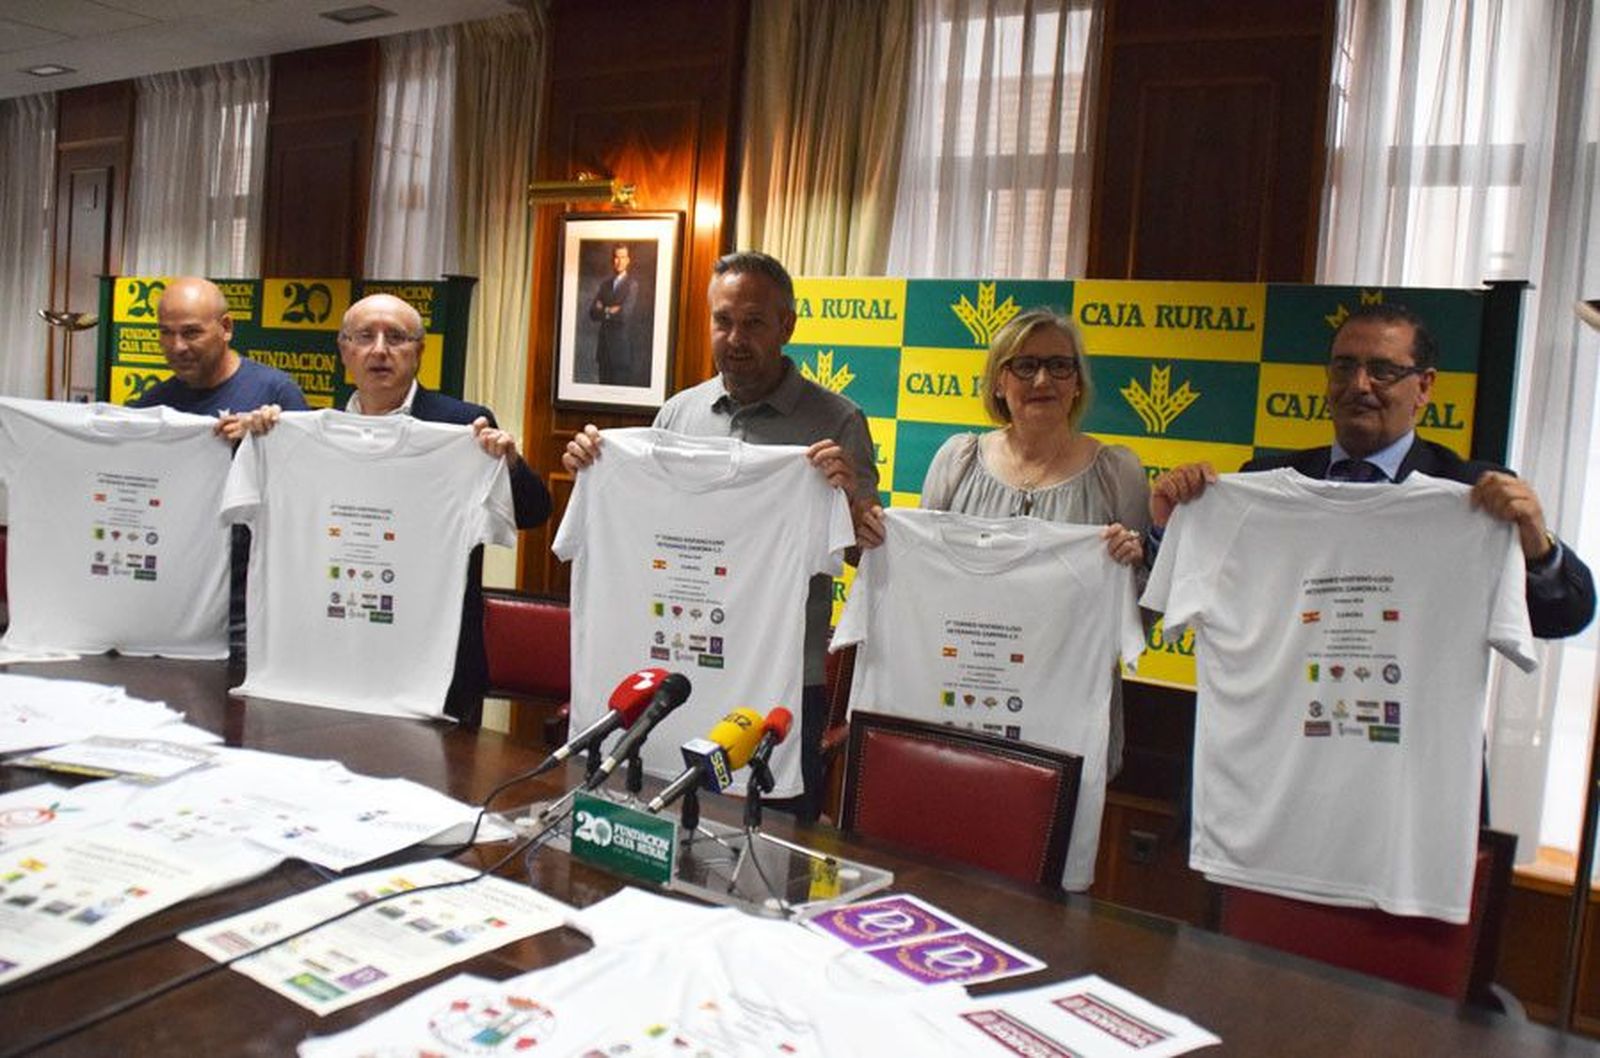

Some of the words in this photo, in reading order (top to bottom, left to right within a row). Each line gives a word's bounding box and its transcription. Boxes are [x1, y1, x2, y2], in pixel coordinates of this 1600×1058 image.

[282, 283, 332, 323] 20
[821, 298, 898, 320] RURAL
[1080, 303, 1144, 328] CAJA
[1155, 305, 1256, 332] RURAL
[906, 373, 962, 397] CAJA
[1266, 393, 1334, 421] CAJA
[575, 811, 612, 847] 20
[613, 823, 671, 851] FUNDACION
